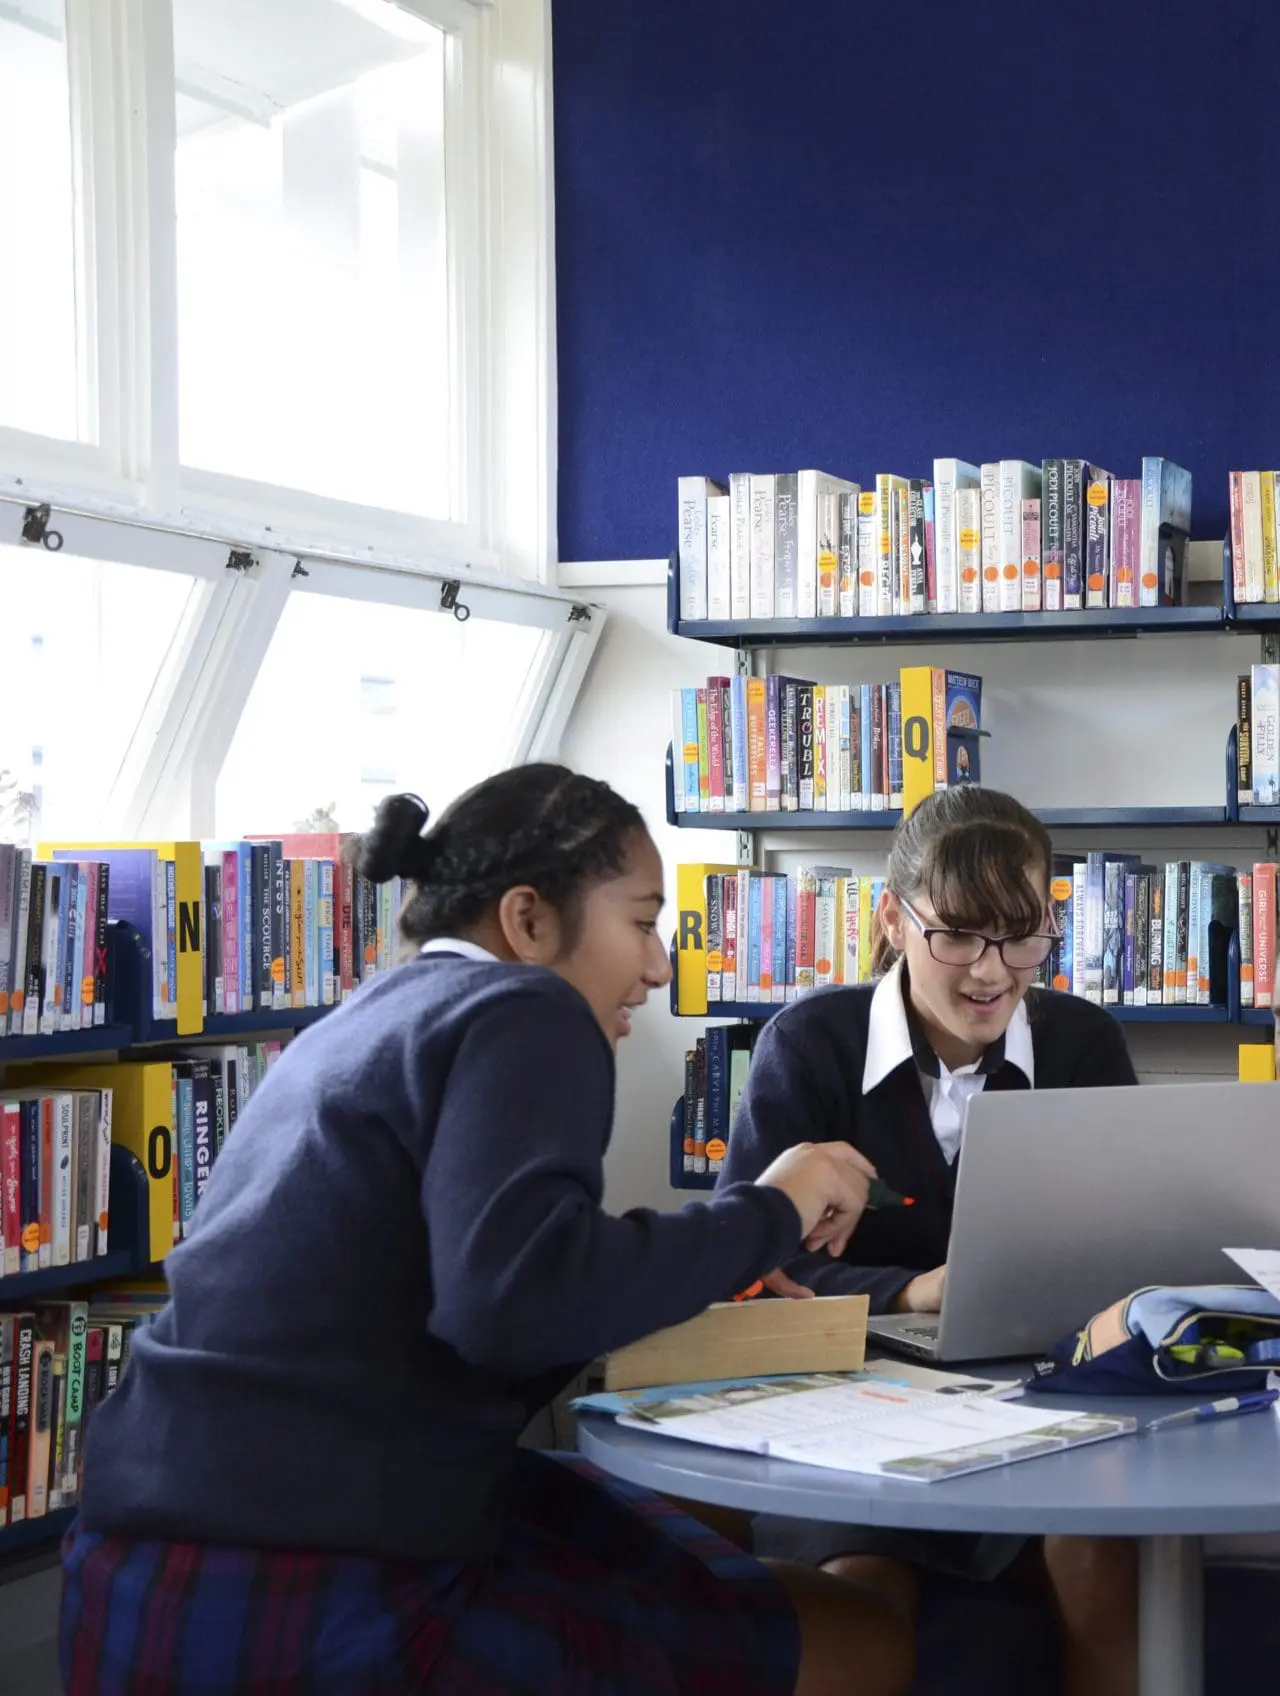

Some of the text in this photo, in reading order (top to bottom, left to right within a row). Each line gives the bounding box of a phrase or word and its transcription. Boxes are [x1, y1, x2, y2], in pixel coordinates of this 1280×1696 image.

[984, 474, 995, 542] PICOULT
[1003, 477, 1014, 536] PICOULT
[1048, 466, 1059, 537] JODI PICOULT
[1066, 466, 1074, 502] PICOULT
[683, 500, 696, 548] Pearse
[711, 514, 721, 550] Pearse
[754, 491, 768, 533] Pearse
[778, 495, 792, 537] Pearse
[1088, 505, 1099, 541] Picoult
[1097, 514, 1106, 534] Jodi
[707, 688, 720, 767] The Edge World
[768, 710, 776, 771] GEEKERELLA
[814, 697, 826, 775] REMIX
[905, 715, 930, 763] Q
[1240, 732, 1250, 766] SURVIVAL
[1256, 720, 1266, 756] FILLY
[1267, 715, 1276, 761] GOLDEN
[20, 860, 30, 913] HAMLET
[276, 863, 284, 914] NESS
[179, 901, 200, 953] N
[262, 908, 271, 970] SCOURGE
[681, 911, 703, 951] R
[710, 899, 718, 931] SNOW
[1076, 885, 1085, 957] ALWAYS FOREVER
[1259, 890, 1267, 984] GIRL UNIVERSE
[1151, 918, 1162, 965] BURNING
[61, 1104, 70, 1148] SOULPRINT
[195, 1100, 209, 1195] RINGER
[17, 1328, 32, 1416] CRASH LANDING
[70, 1342, 83, 1413] BOOT CAMP
